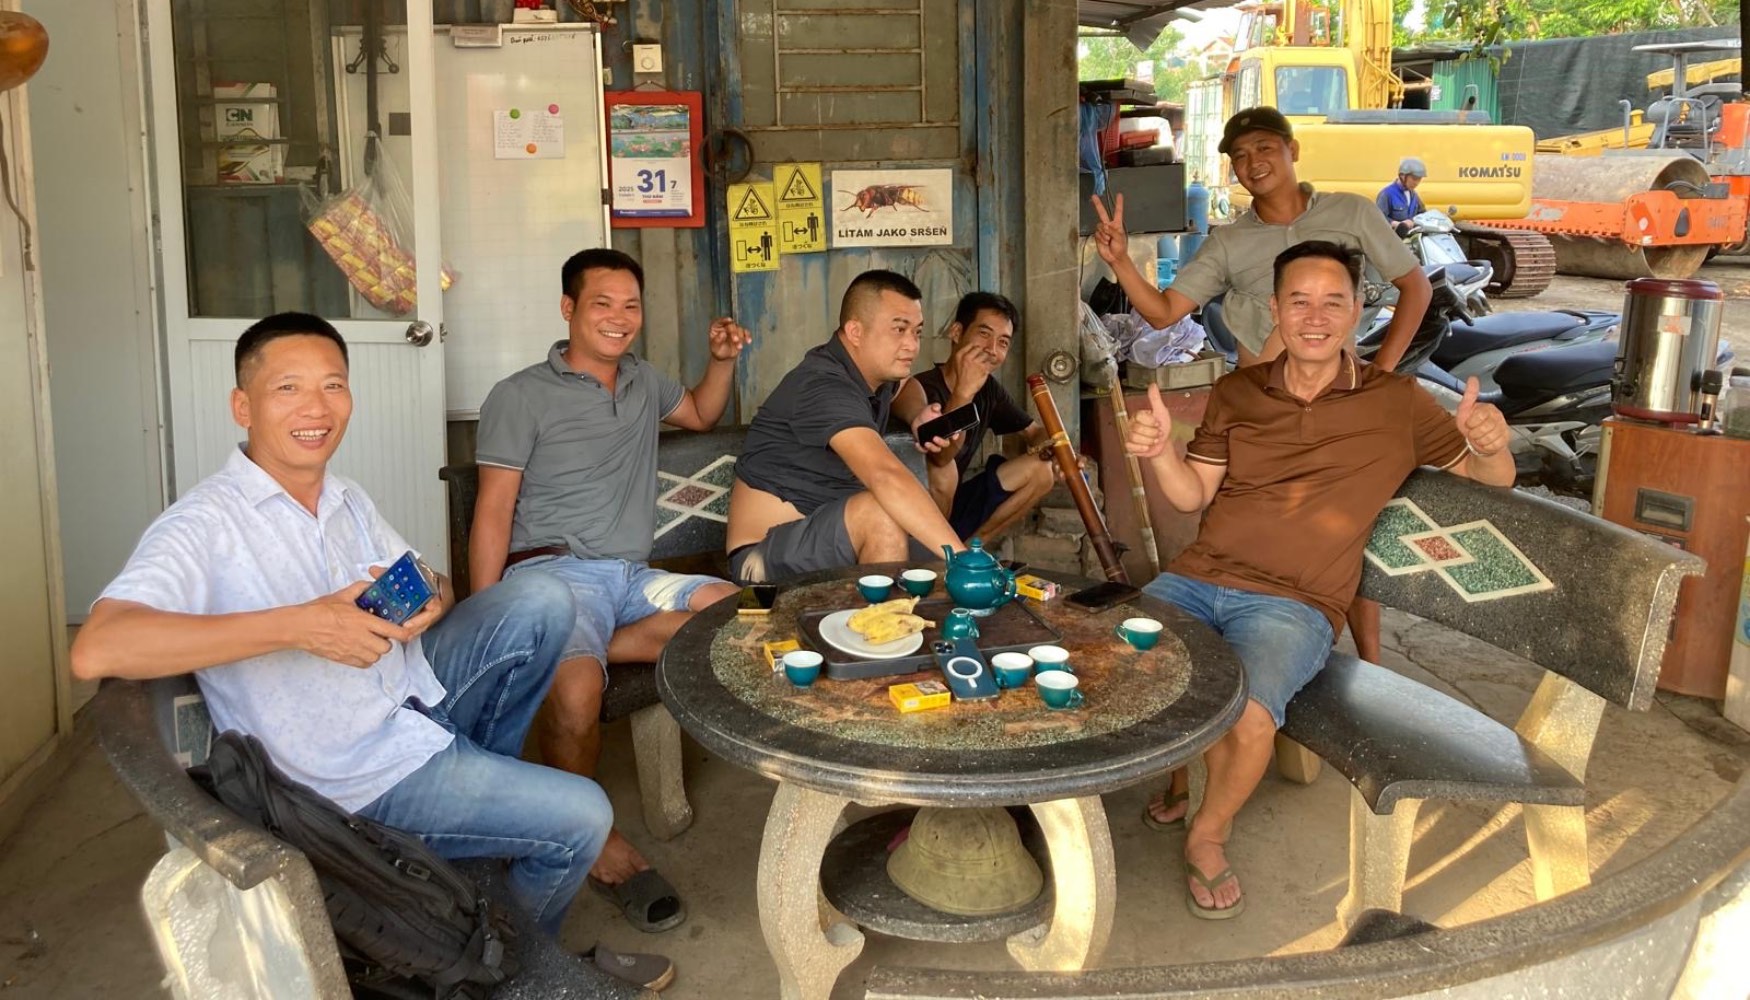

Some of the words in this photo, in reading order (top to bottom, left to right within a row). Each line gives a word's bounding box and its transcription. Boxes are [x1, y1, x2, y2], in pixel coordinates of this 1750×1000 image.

[226, 109, 253, 121] CN
[1459, 165, 1520, 177] KOMATSU
[637, 170, 666, 192] 31
[670, 180, 677, 190] 7
[877, 228, 907, 238] JAKO
